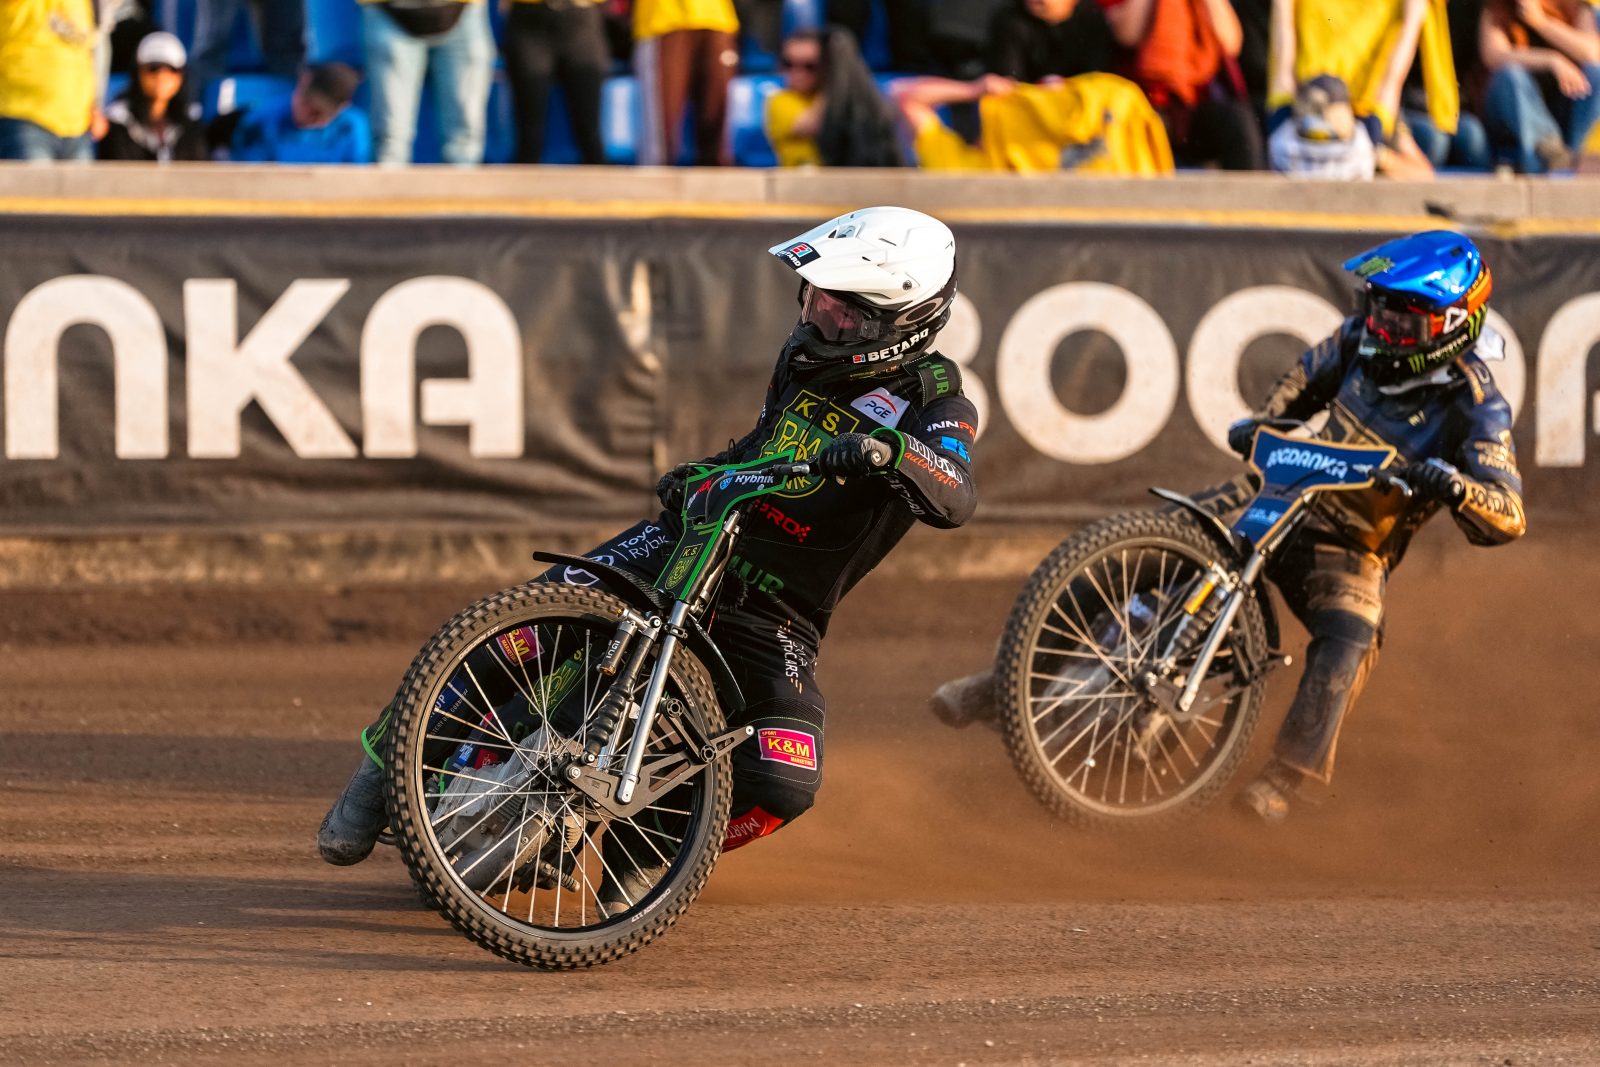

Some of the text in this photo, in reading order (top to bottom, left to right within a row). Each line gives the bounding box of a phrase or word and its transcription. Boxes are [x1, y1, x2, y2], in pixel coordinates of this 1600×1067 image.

[867, 328, 930, 363] BETARD
[864, 400, 893, 419] PGE
[734, 473, 775, 488] Rybnik
[767, 737, 811, 758] K&M
